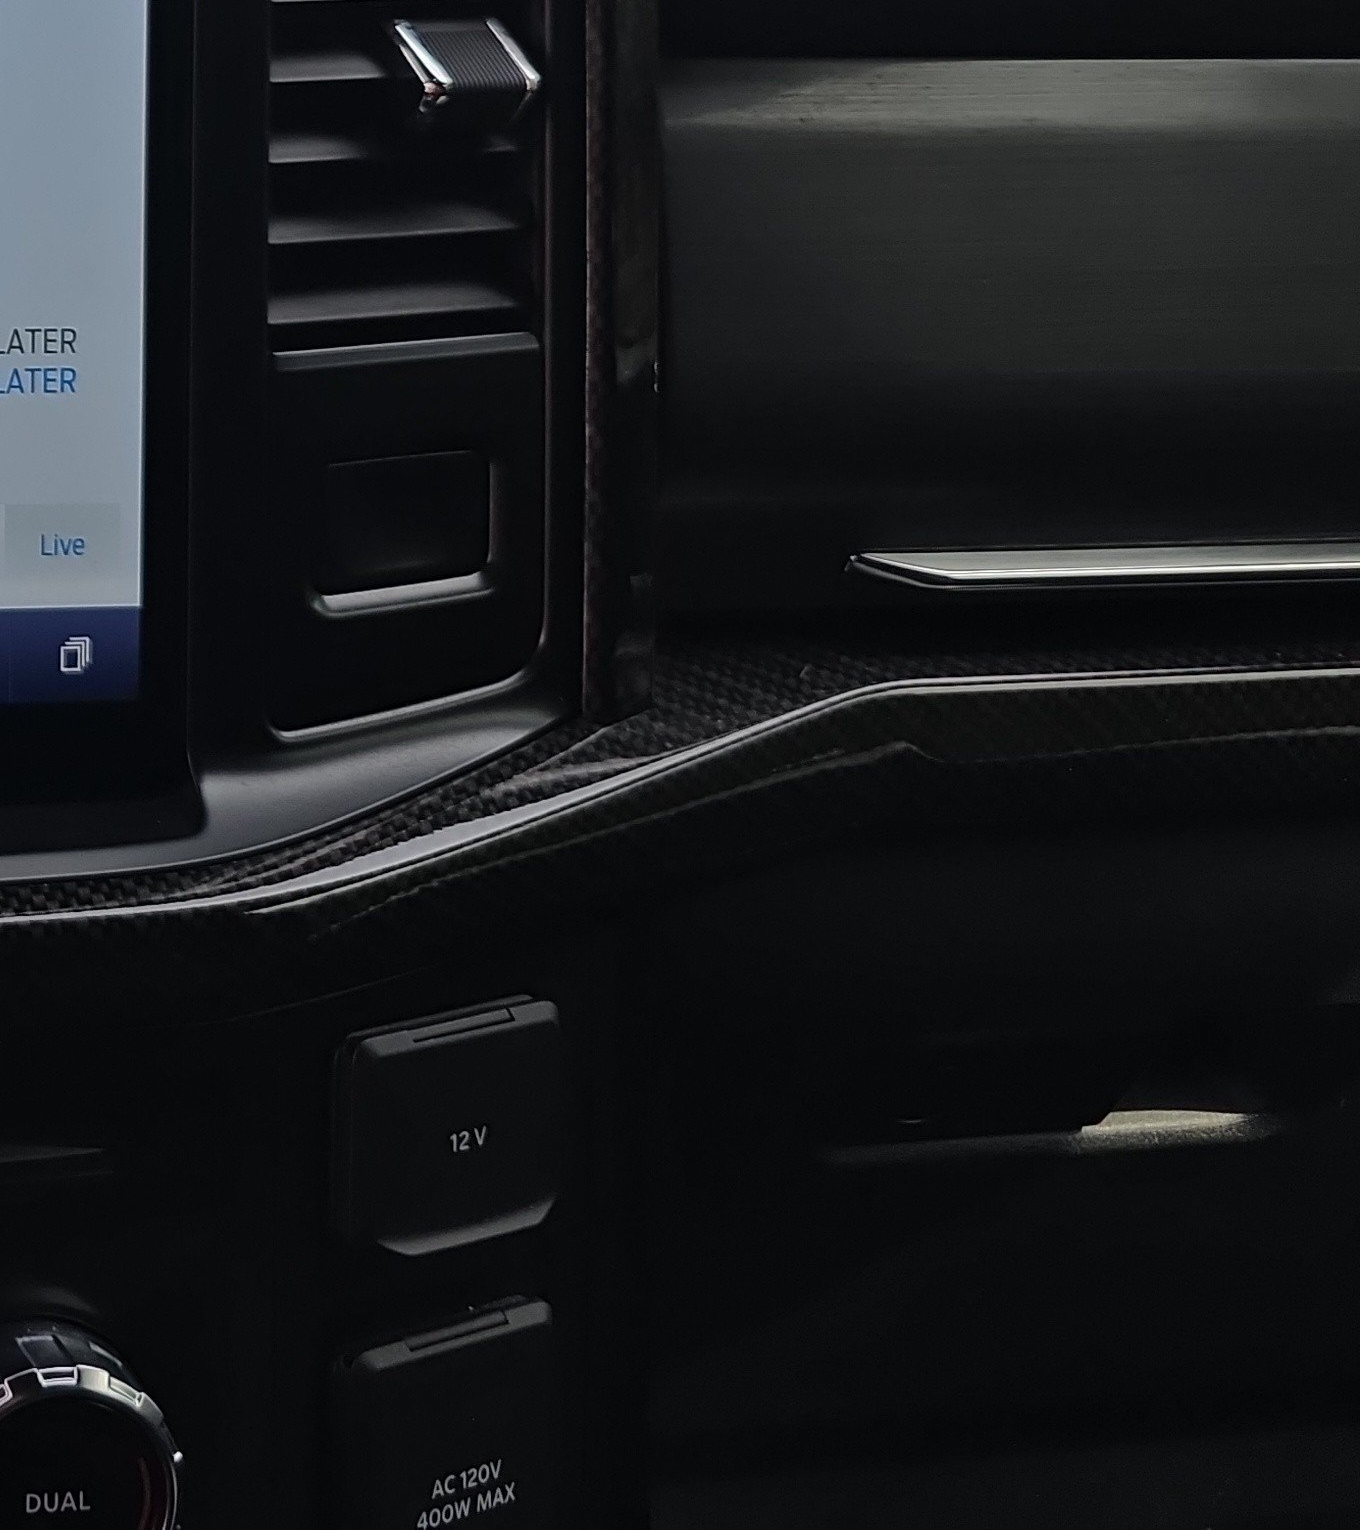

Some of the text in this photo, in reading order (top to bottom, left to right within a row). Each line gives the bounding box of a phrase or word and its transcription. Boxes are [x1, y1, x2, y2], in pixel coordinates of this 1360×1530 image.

[40, 534, 86, 558] Live
[449, 1126, 487, 1152] 12 V
[432, 1458, 502, 1499] AC 120V
[25, 1490, 91, 1515] DUAL
[416, 1482, 516, 1530] 400W MAX
